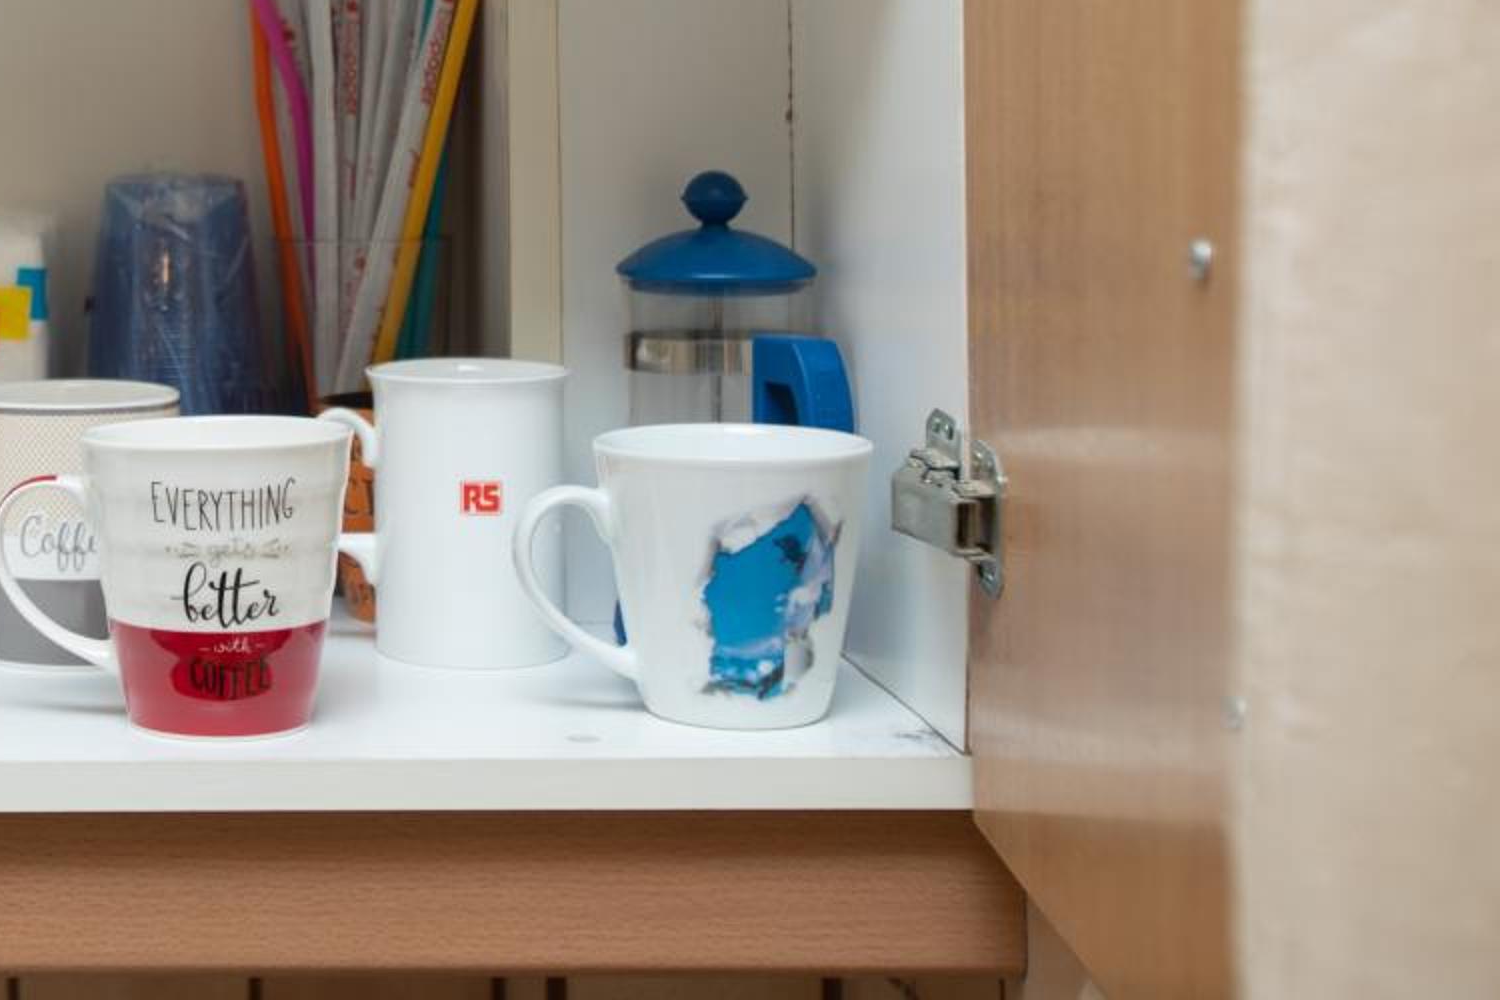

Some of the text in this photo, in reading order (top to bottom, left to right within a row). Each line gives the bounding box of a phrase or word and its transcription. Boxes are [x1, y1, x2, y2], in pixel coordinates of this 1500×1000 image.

[150, 476, 296, 532] EVERYTHING
[462, 483, 501, 512] RS
[170, 560, 280, 629] better
[213, 636, 251, 654] with
